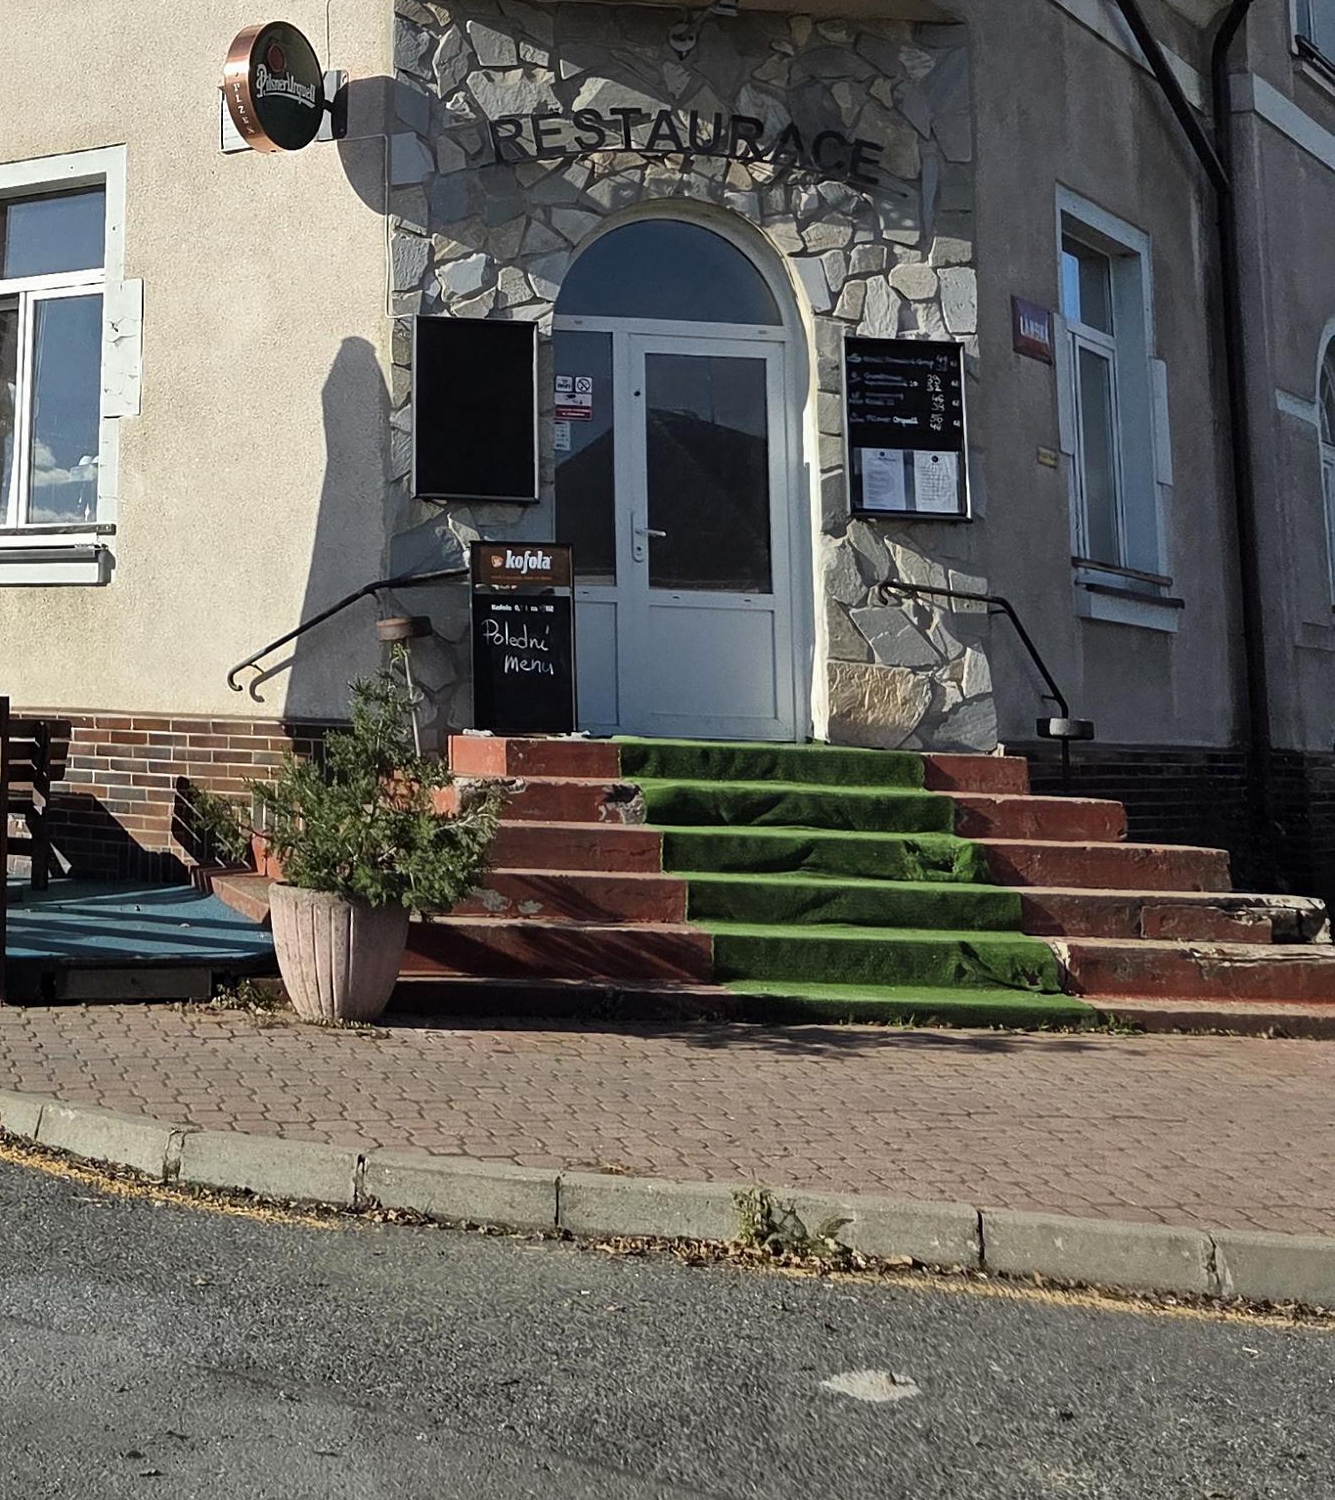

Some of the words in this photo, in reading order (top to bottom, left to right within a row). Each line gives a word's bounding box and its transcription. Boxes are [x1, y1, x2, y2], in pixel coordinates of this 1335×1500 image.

[256, 64, 287, 98] Pilsner
[286, 72, 316, 105] Urquell
[490, 107, 885, 186] RESTAURACE
[505, 550, 551, 574] kofola
[481, 619, 548, 651] Polední
[505, 655, 554, 675] menu
